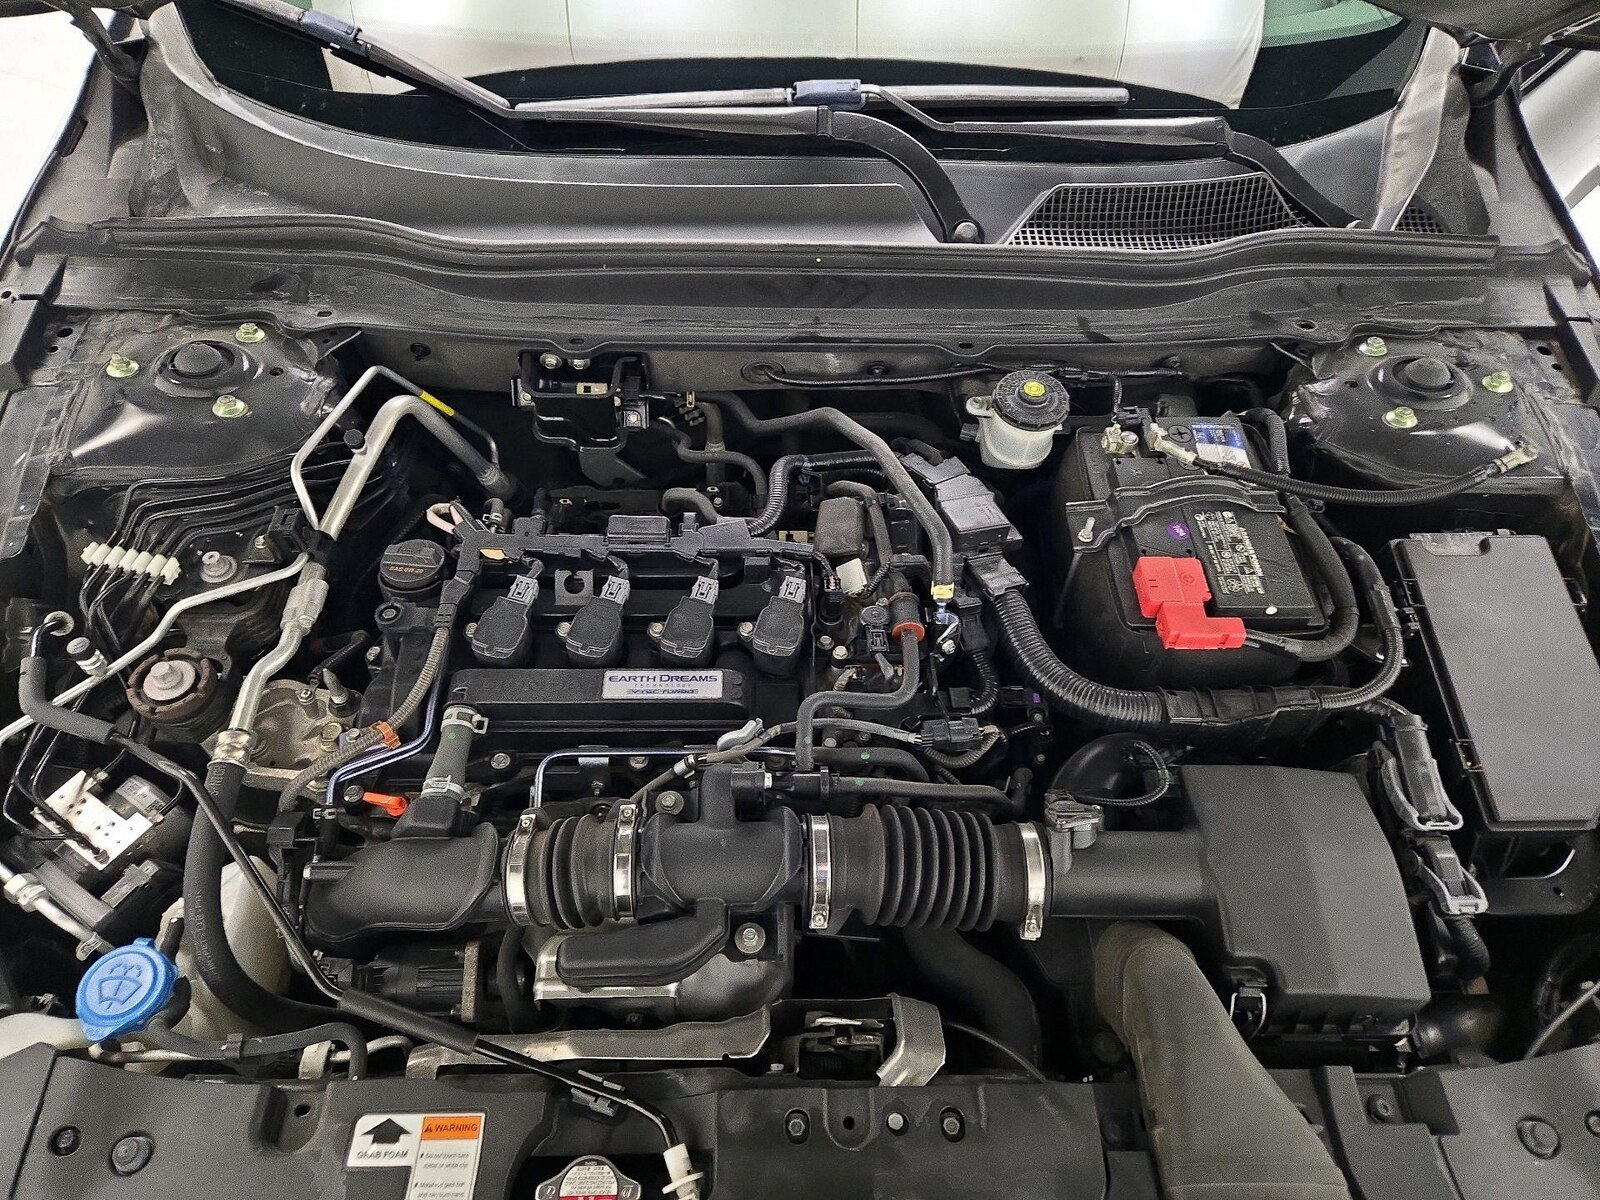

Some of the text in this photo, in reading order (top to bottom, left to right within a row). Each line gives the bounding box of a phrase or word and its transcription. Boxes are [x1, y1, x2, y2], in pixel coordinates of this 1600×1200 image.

[608, 674, 718, 683] EARTH DREAMS
[435, 1123, 478, 1133] WARNING
[356, 1149, 409, 1160] GRAB FOAM
